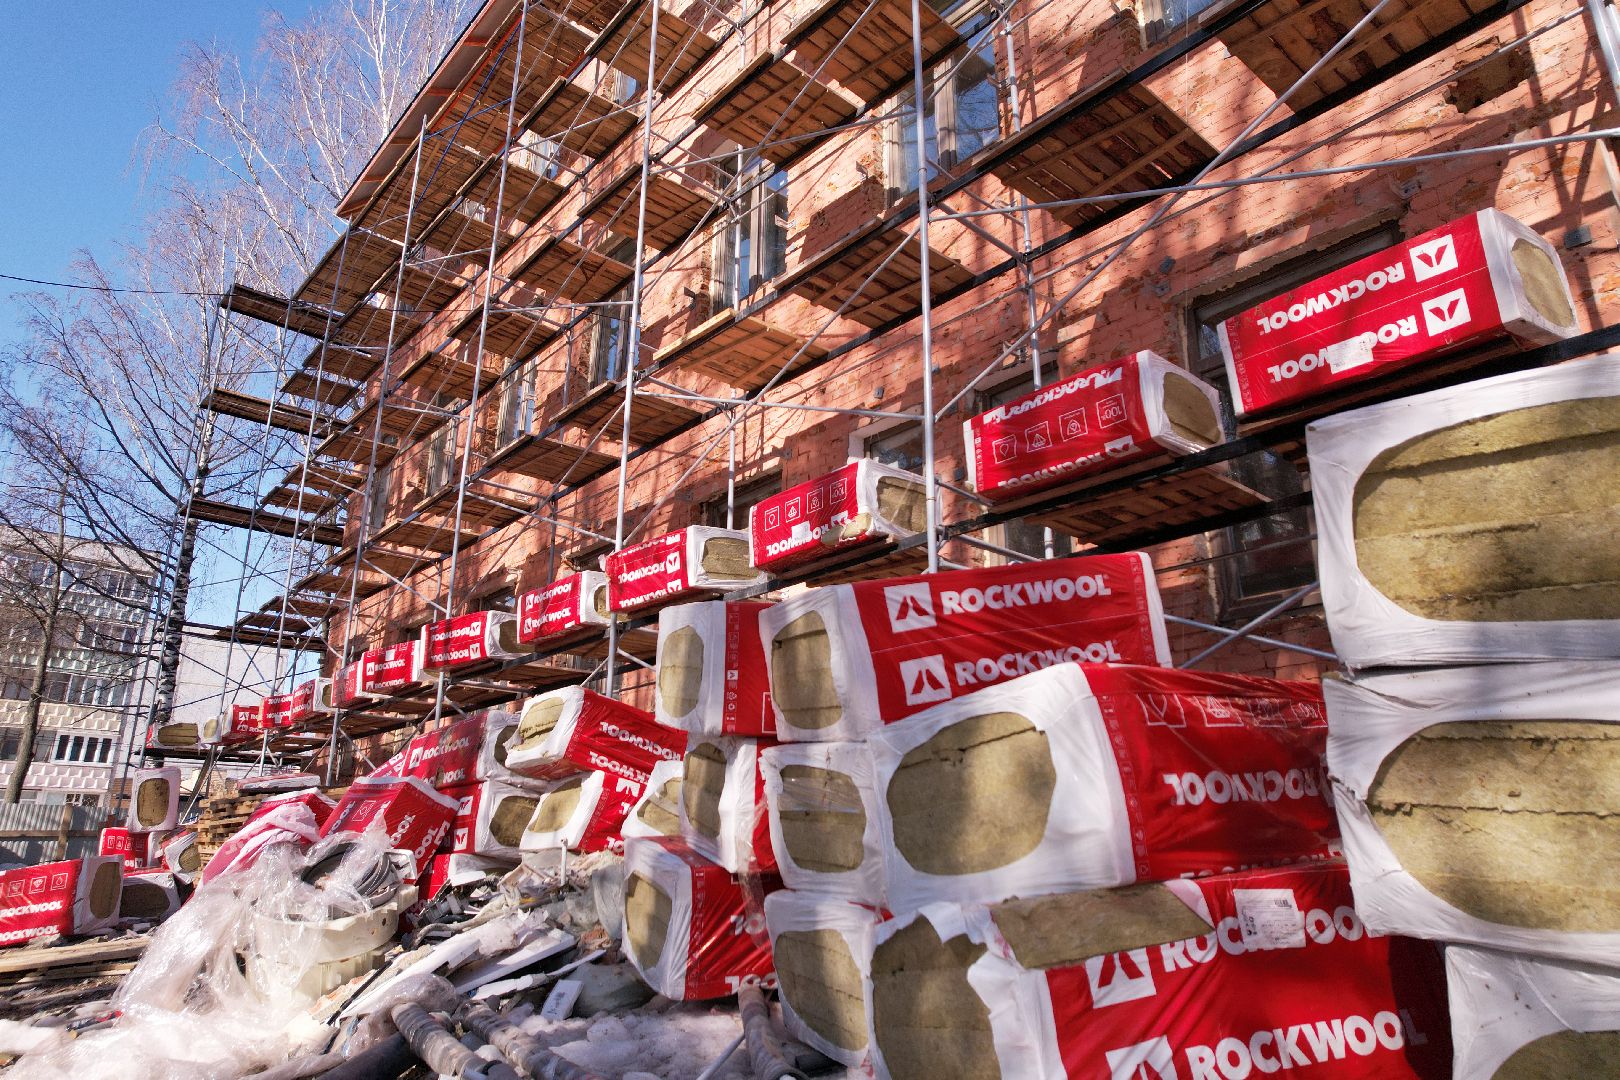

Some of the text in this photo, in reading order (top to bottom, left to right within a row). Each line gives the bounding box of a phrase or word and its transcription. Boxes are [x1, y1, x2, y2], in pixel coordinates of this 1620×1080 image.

[1257, 262, 1406, 335] ROCKWOOL
[940, 574, 1112, 615] ROCKWOOL
[1185, 1010, 1429, 1080] ROCKWOOL
